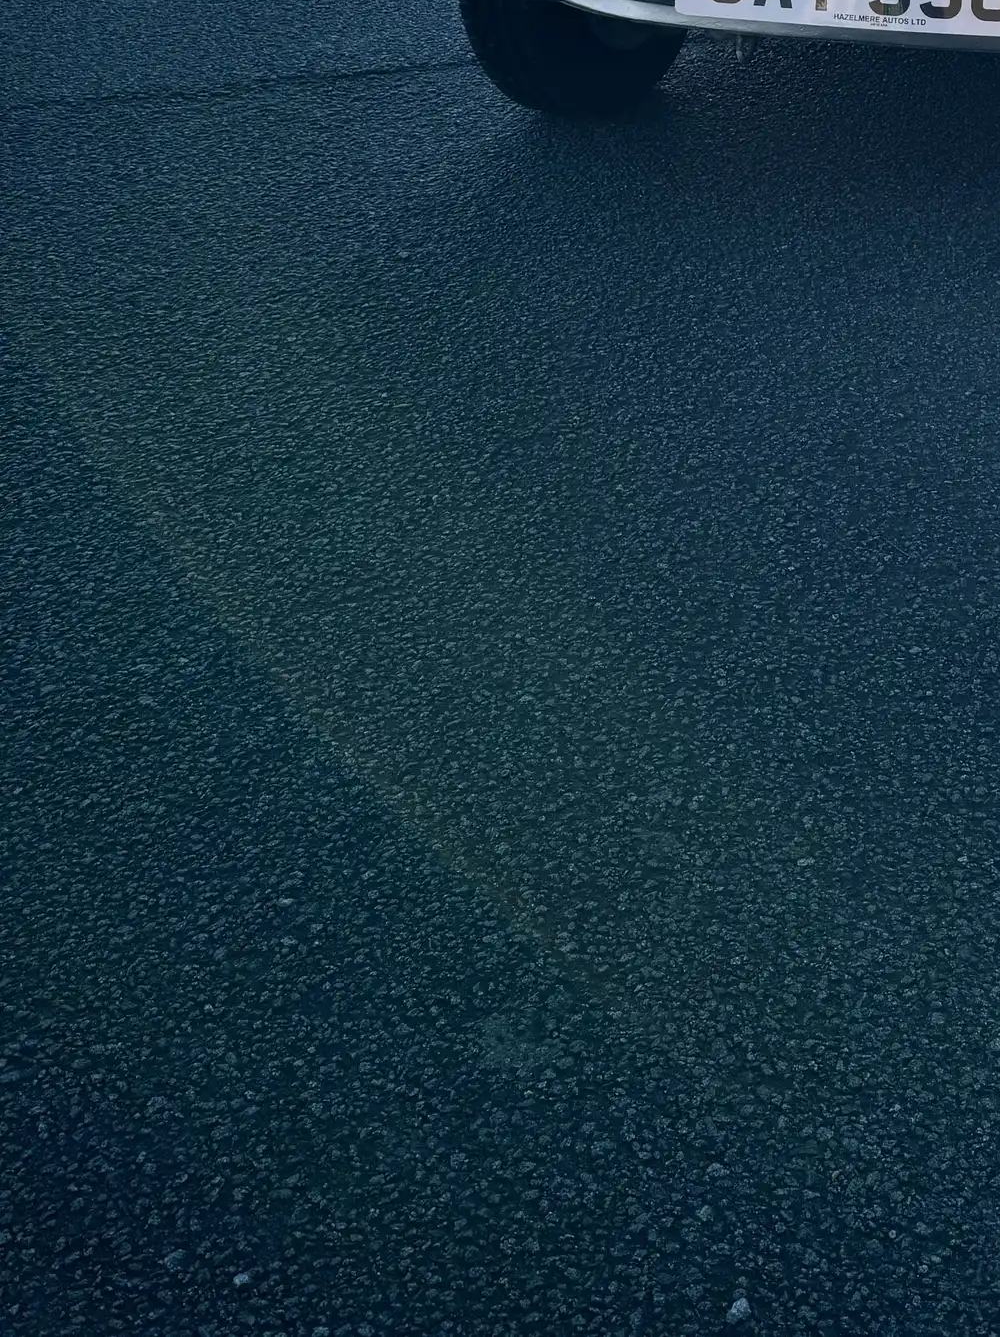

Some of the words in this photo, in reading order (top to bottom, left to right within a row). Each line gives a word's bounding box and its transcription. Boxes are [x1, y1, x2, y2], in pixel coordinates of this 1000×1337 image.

[833, 13, 880, 23] HAZELMERE
[882, 17, 909, 25] AUTOS
[911, 18, 927, 26] LTD
